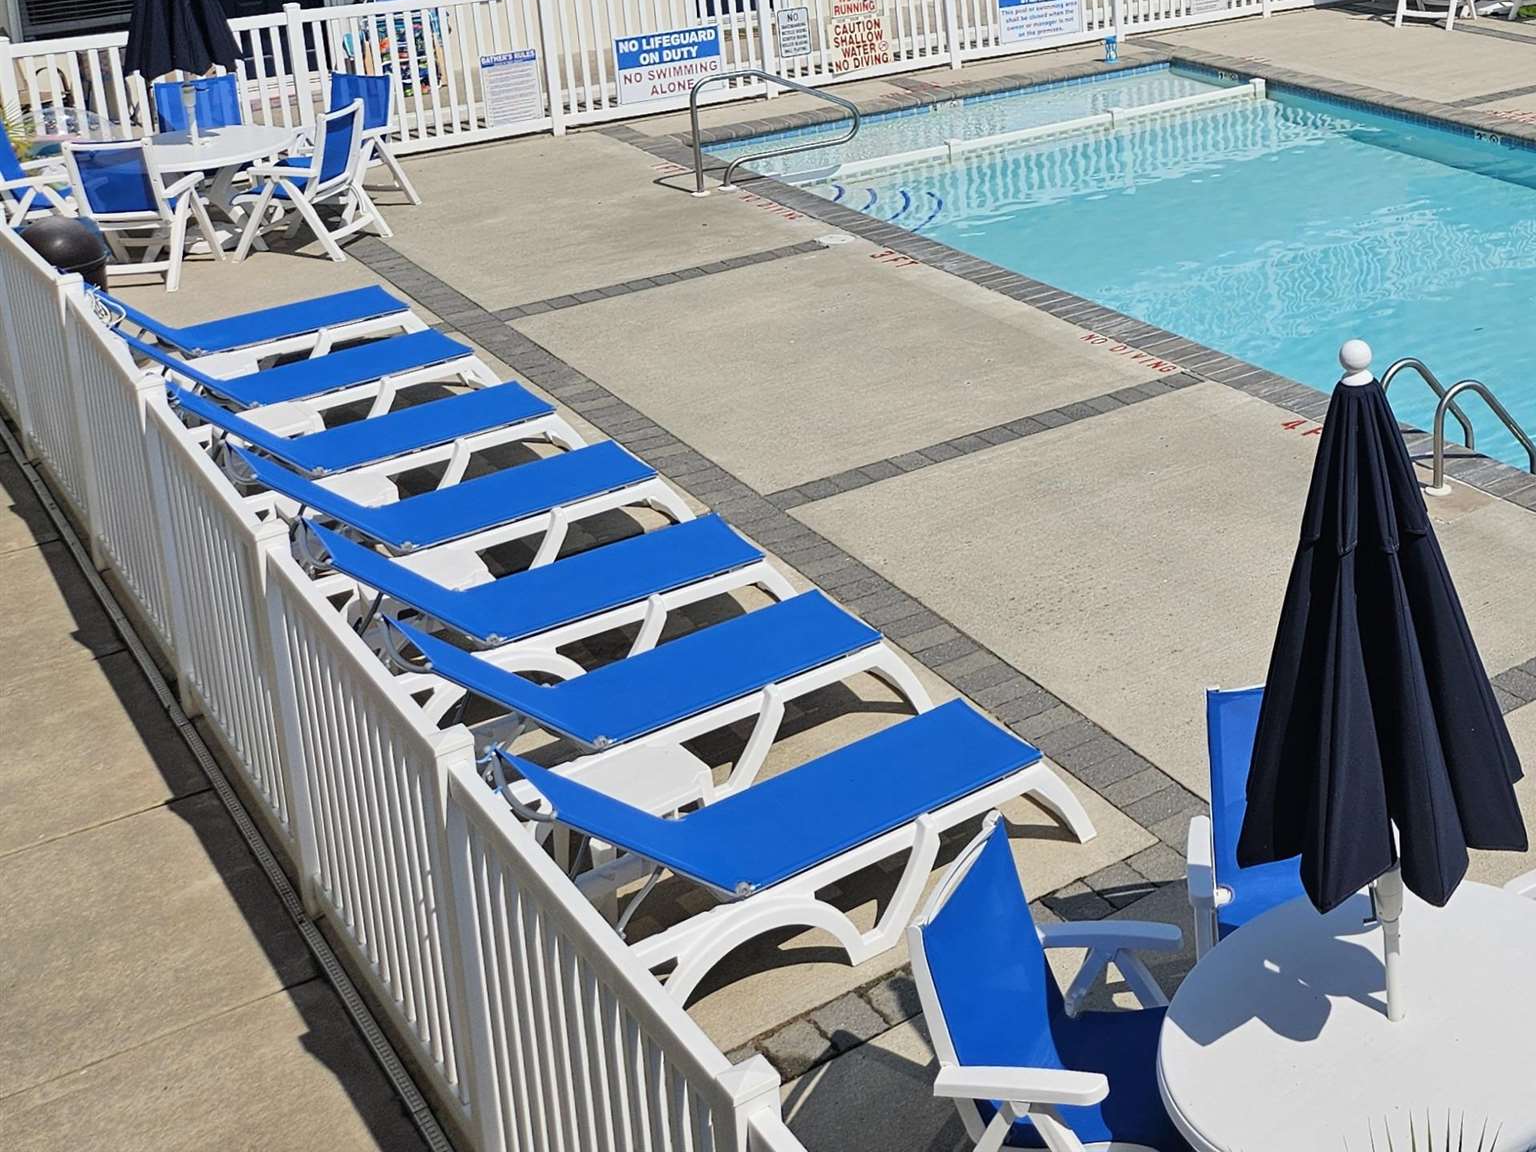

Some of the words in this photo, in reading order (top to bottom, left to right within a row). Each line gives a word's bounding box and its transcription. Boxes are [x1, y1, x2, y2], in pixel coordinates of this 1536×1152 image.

[786, 12, 799, 22] NO
[833, 0, 875, 16] RUNNING
[1015, 7, 1027, 15] pool
[1036, 2, 1064, 11] swimming
[1029, 12, 1048, 20] closed
[834, 18, 881, 36] CAUTION
[618, 40, 639, 54] NO
[642, 29, 716, 51] LIFEGUARD
[833, 29, 883, 48] SHALLOW
[639, 53, 659, 65] ON
[662, 45, 699, 62] DUTY
[841, 42, 877, 59] WATER
[834, 59, 850, 72] NO
[853, 52, 889, 69] DIVING
[623, 72, 643, 85] NO
[648, 60, 718, 81] SWIMMING
[650, 78, 695, 96] ALONE
[1079, 333, 1109, 345] NO
[1109, 344, 1178, 373] DIVING
